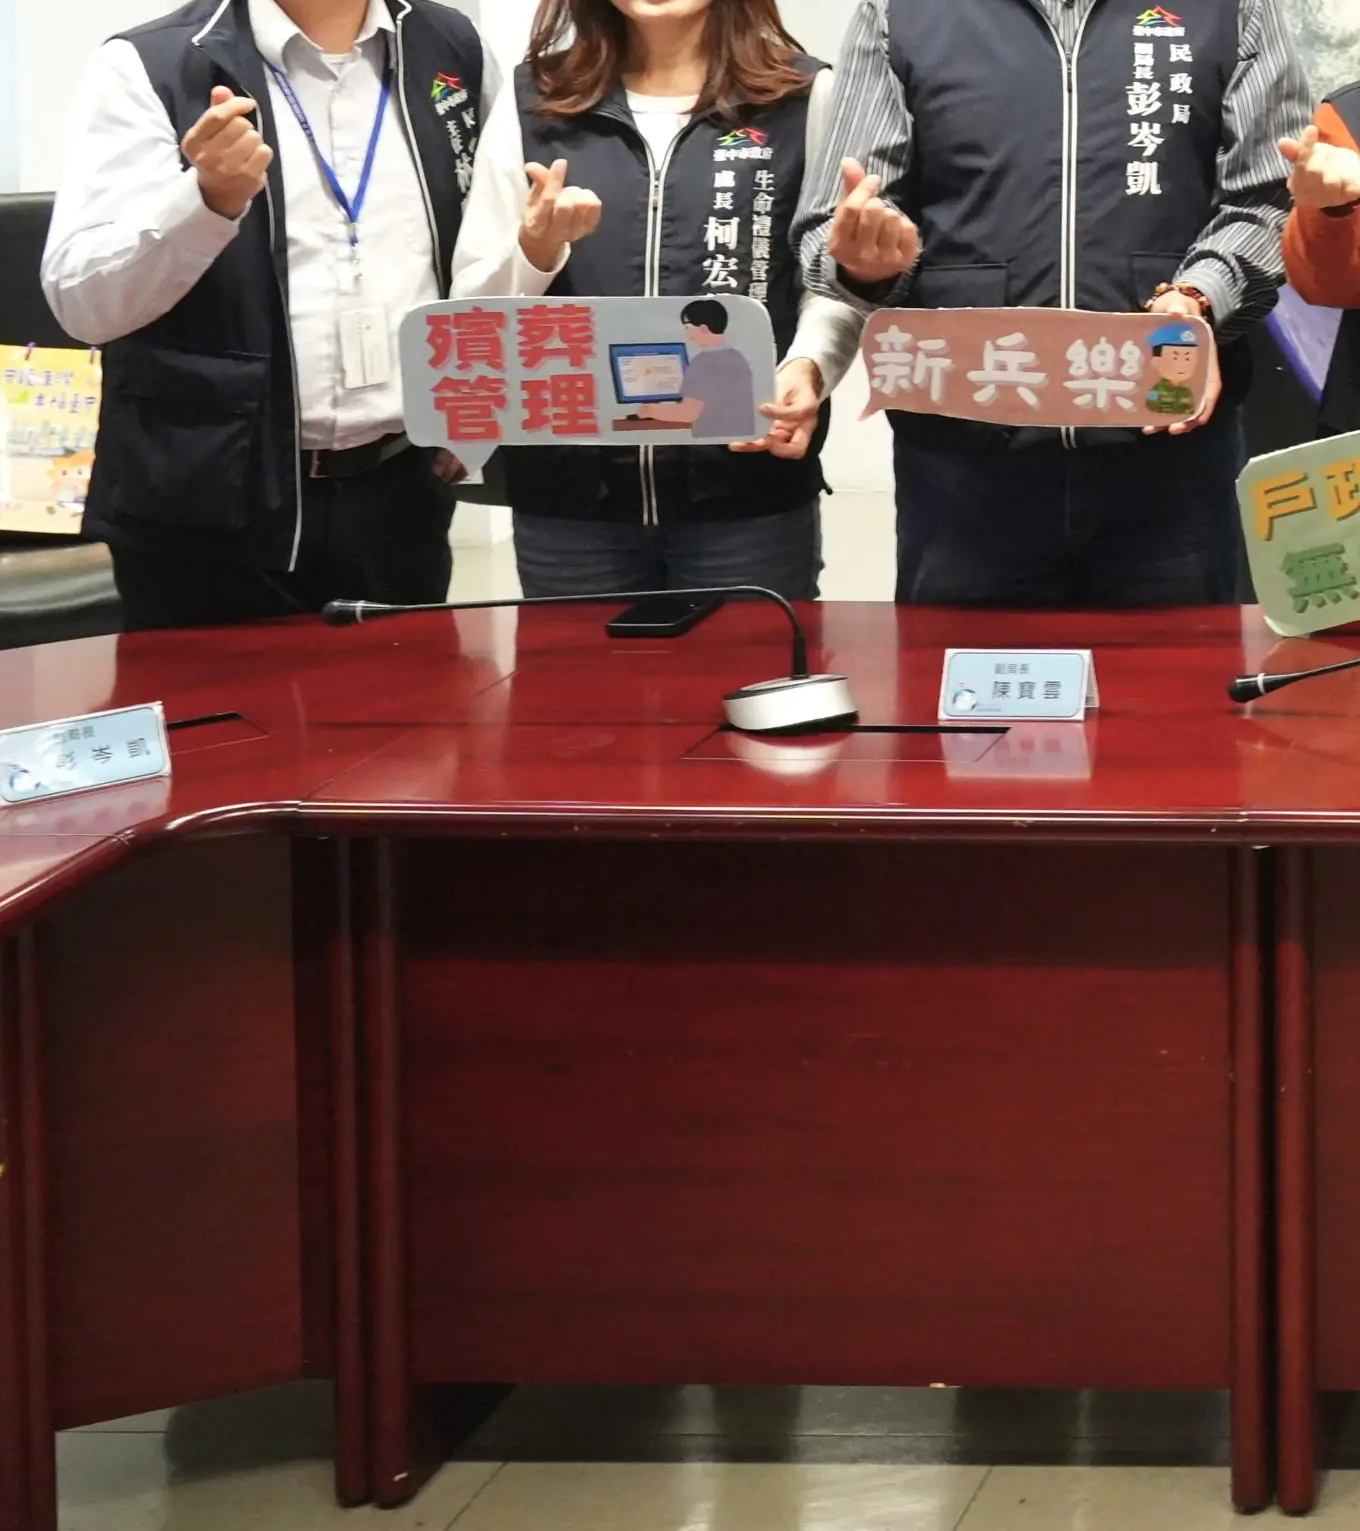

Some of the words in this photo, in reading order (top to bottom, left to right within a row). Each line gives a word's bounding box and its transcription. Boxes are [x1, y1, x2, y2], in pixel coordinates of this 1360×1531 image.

[1169, 43, 1193, 124] 民政局
[1125, 82, 1165, 196] 彭岑凱
[702, 216, 740, 296] 柯宏
[425, 303, 600, 372] 殯葬
[870, 325, 1145, 410] 新兵樂
[431, 374, 601, 442] 管理
[991, 680, 1062, 700] 陳寶雲
